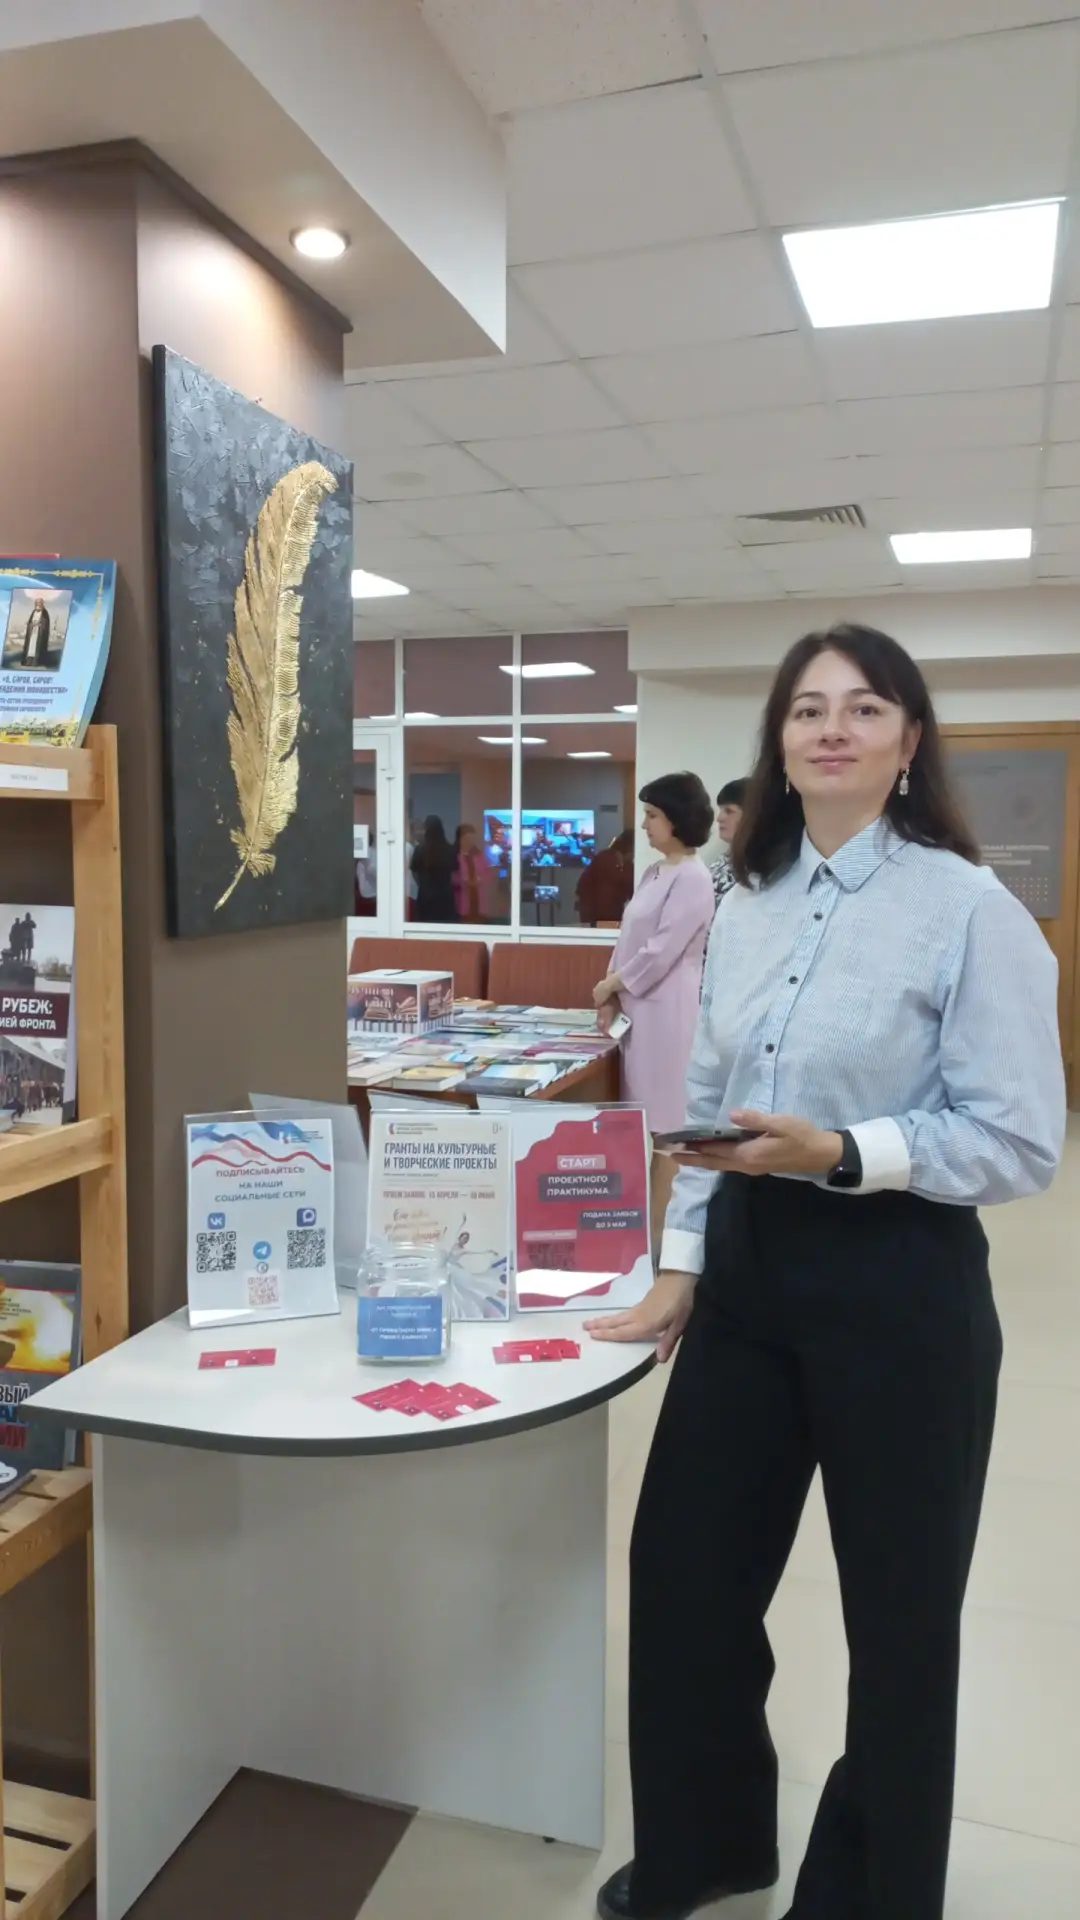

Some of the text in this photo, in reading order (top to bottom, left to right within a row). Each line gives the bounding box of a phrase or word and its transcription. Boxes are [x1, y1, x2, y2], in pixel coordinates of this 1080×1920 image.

[2, 997, 53, 1015] РУБЕЖ:
[19, 1018, 56, 1030] ФРОНТА
[384, 1142, 497, 1155] ГРАНТЫ НА КУЛЬТУРНЫЕ
[384, 1157, 497, 1169] И ТВОРЧЕСКИЕ ПРОЕКТЫ
[559, 1157, 597, 1168] СТАРТ
[216, 1166, 305, 1178] ПОДПИСЫВАЙТЕСЬ
[254, 1180, 283, 1188] НАШИ
[548, 1175, 608, 1184] ПРОЕКТНОГО
[214, 1190, 307, 1202] СОЦИАЛЬНЫЕ СЕТИ
[547, 1187, 609, 1196] ПРАКТИКУМА
